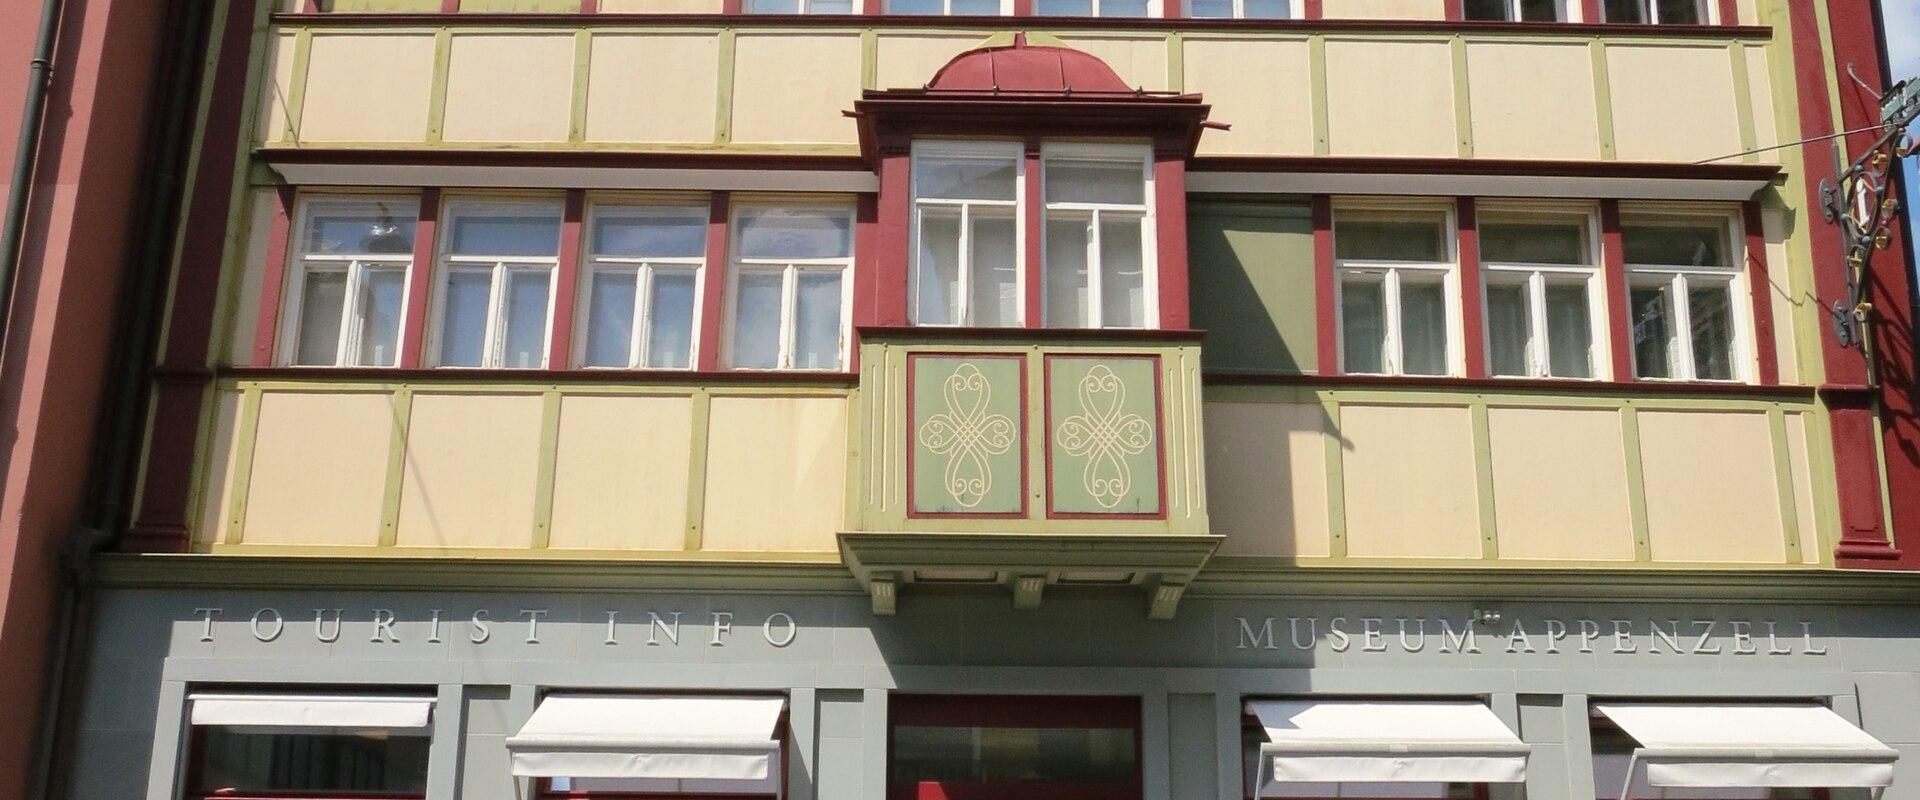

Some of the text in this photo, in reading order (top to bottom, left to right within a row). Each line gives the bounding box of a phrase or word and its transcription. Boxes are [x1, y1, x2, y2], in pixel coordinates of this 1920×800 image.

[195, 607, 798, 648] TOURIST INFO
[1238, 616, 1828, 655] MUSEUM APPENZELL
